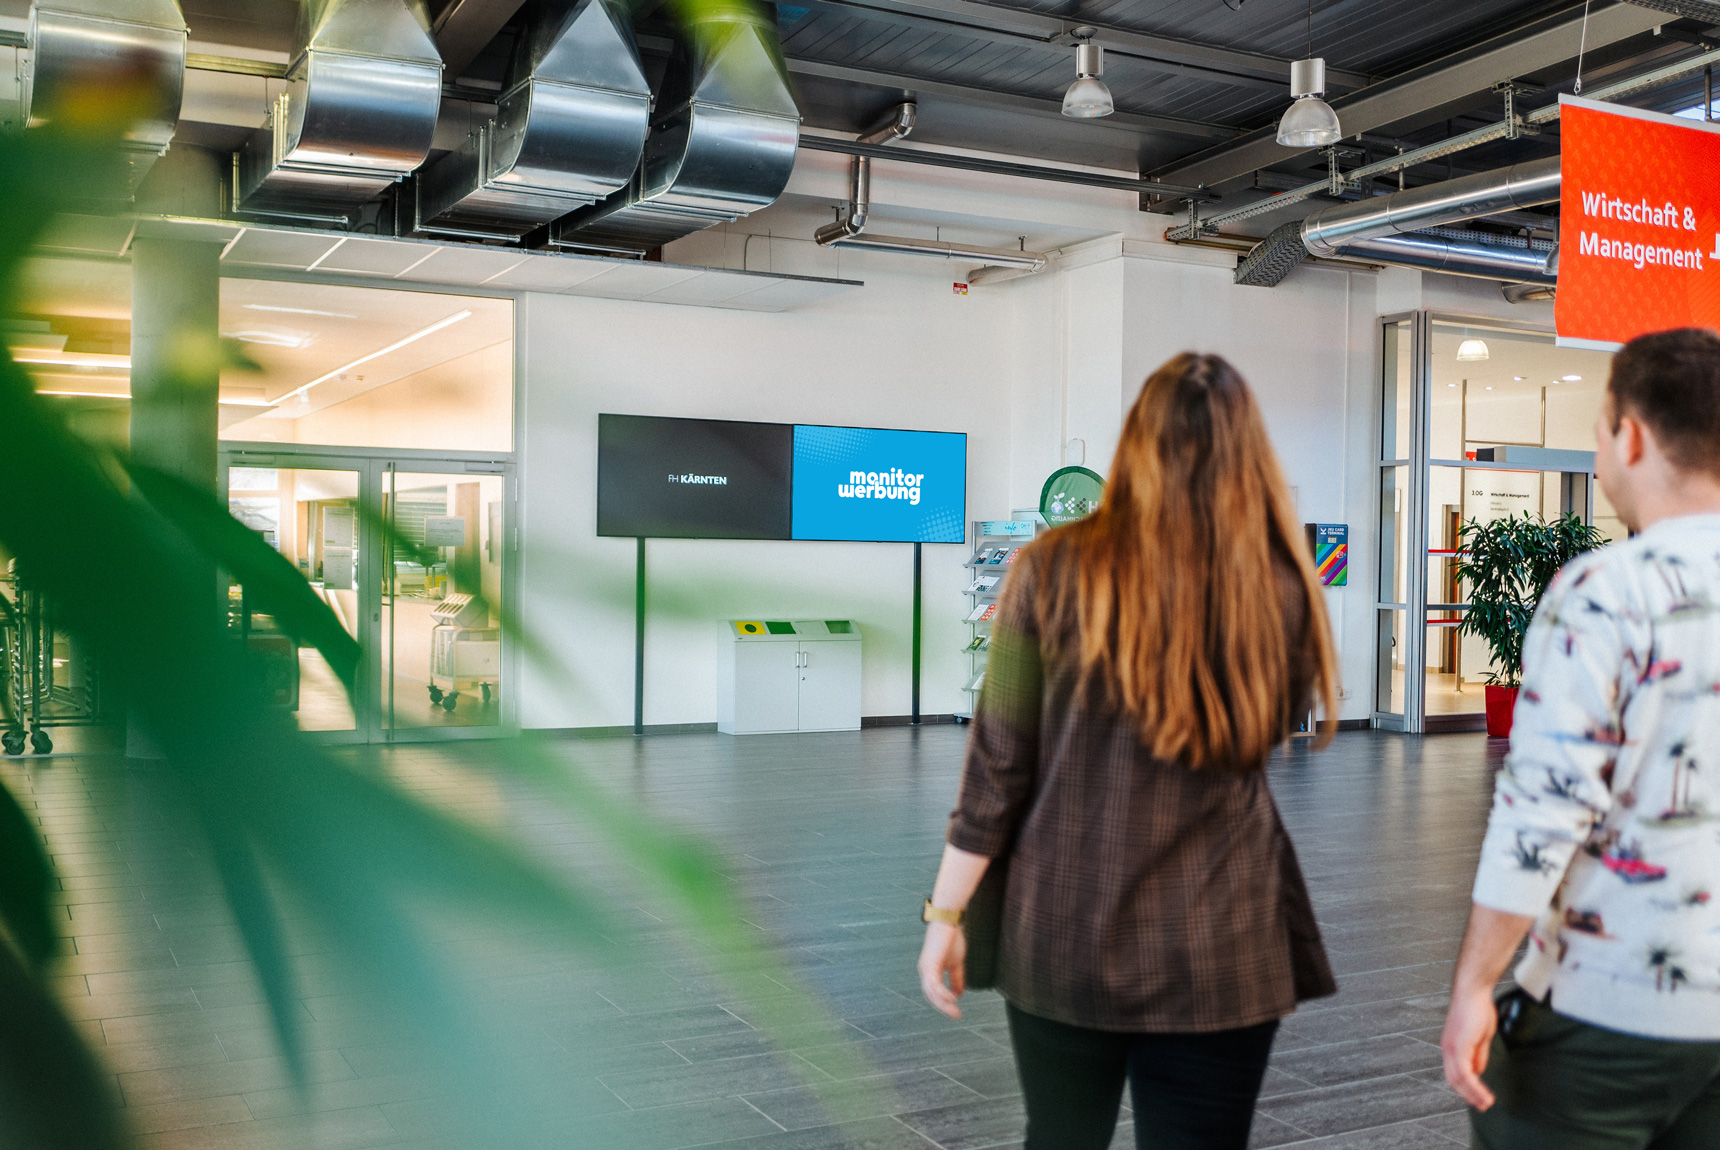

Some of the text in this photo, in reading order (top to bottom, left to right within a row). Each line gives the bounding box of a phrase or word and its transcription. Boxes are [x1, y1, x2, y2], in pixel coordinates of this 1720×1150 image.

[1581, 191, 1697, 232] Wirtschaft &
[1579, 231, 1703, 270] Management
[668, 474, 679, 483] FH
[850, 467, 924, 487] monitor
[838, 480, 921, 505] werbung
